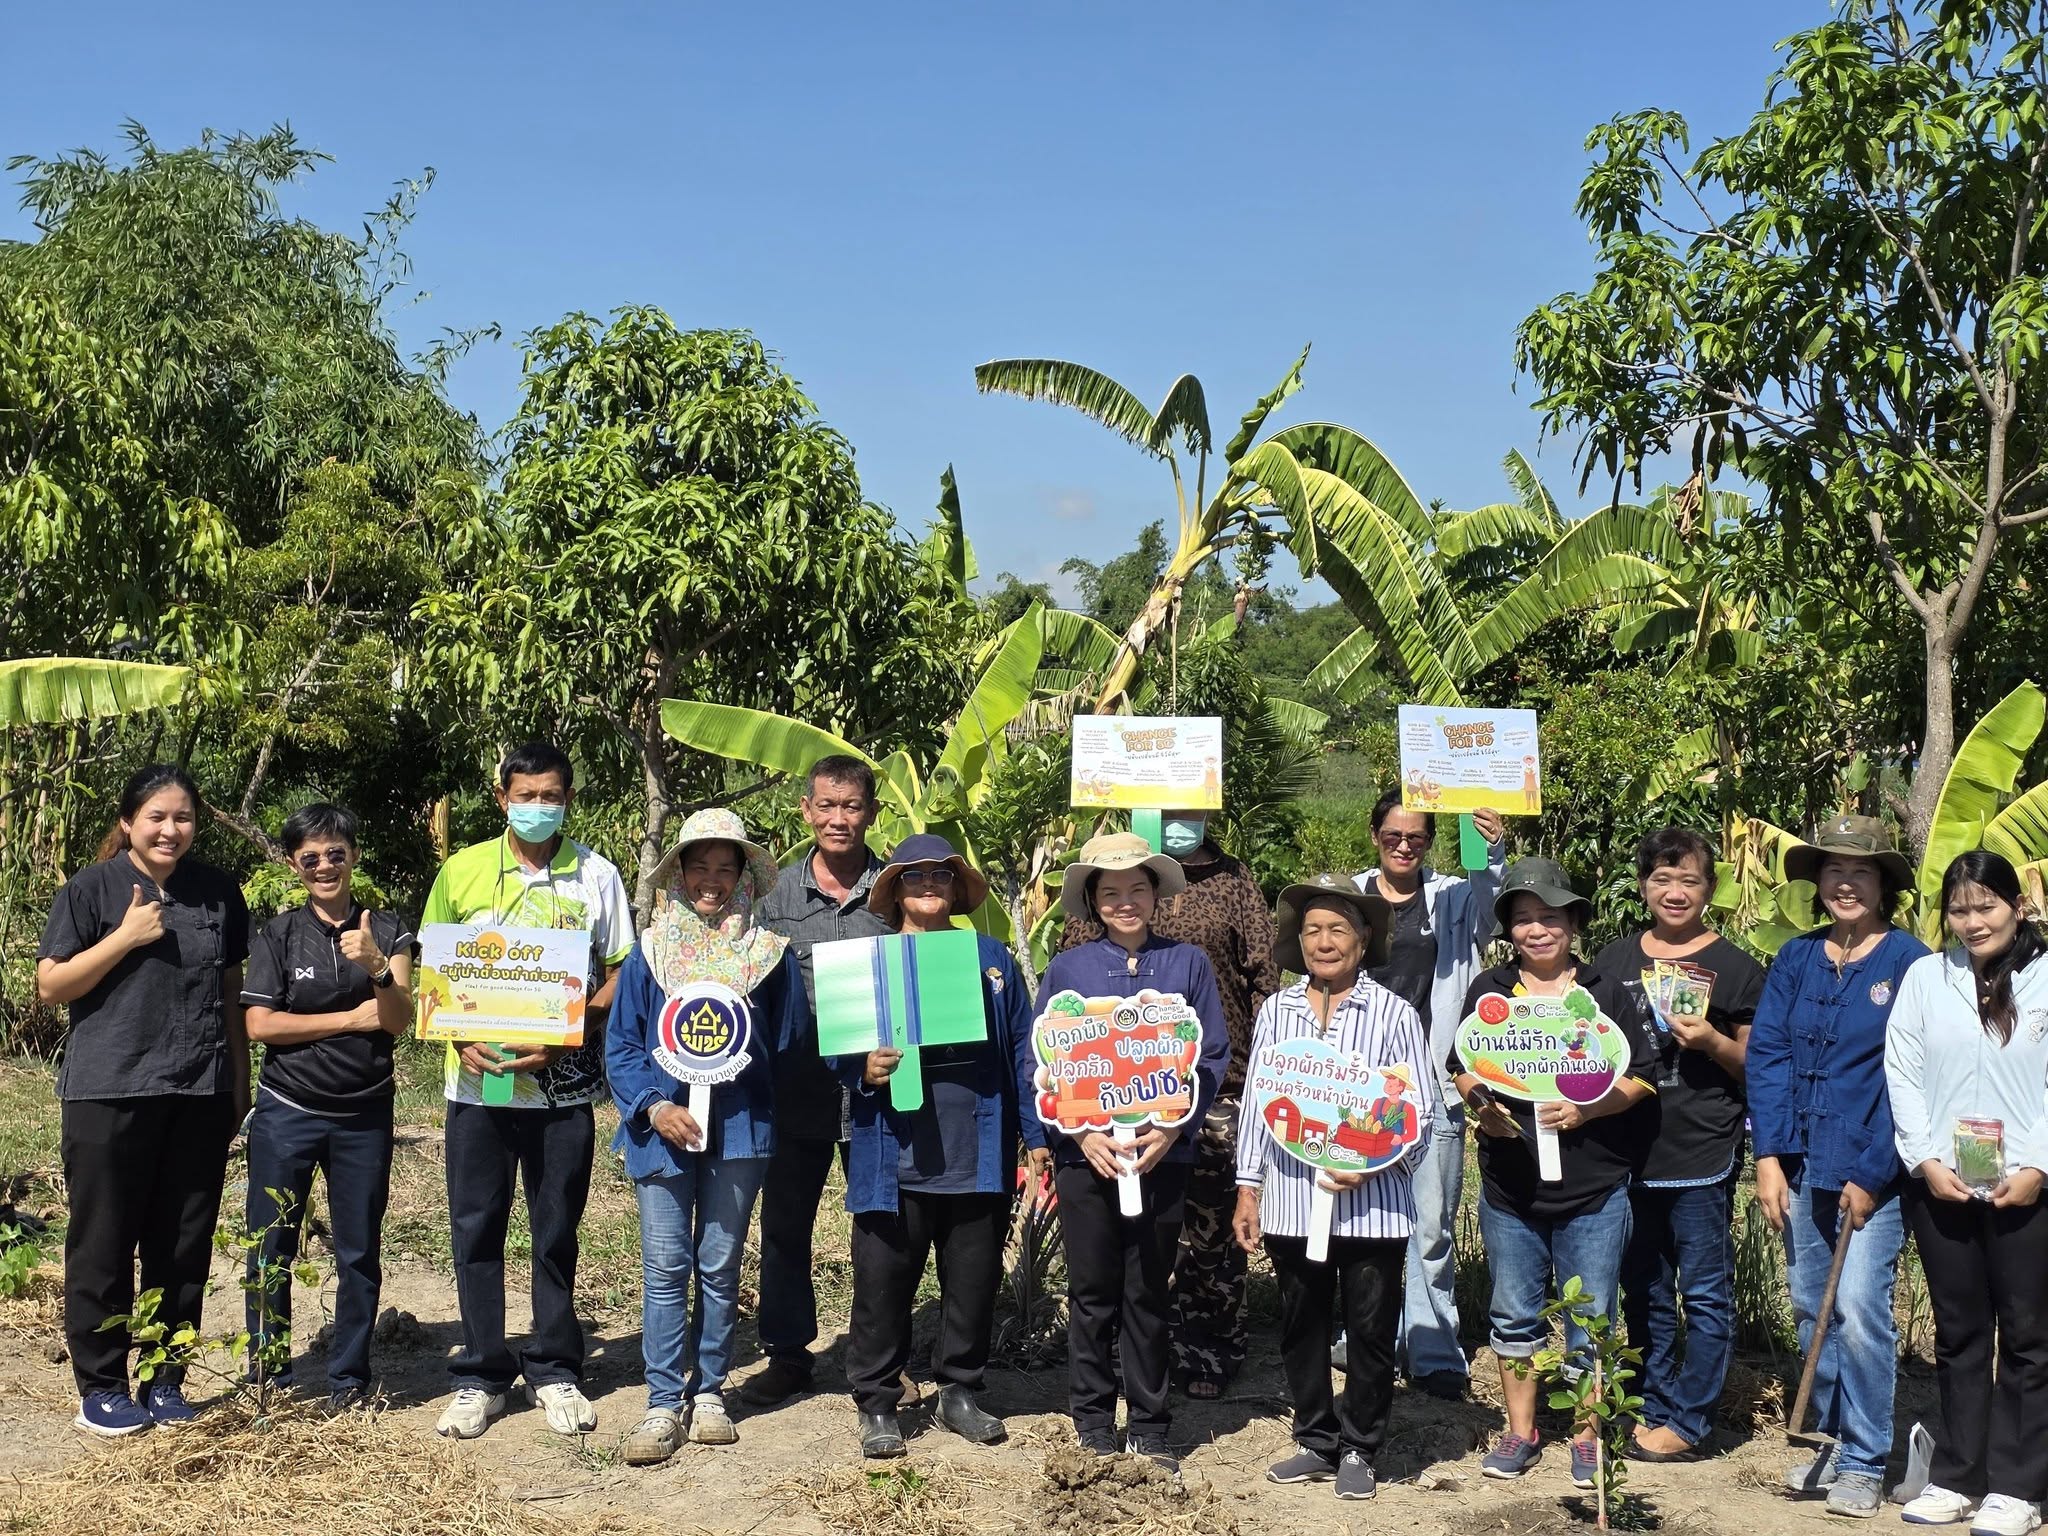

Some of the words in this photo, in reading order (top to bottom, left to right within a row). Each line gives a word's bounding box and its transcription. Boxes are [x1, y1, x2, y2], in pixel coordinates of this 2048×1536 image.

[1121, 727, 1177, 742] CHANGE
[1444, 721, 1495, 737] CHANGE
[1448, 735, 1474, 749] FOR
[1126, 740, 1153, 752] FOR
[456, 941, 502, 960] Kick
[508, 945, 543, 961] off
[1043, 1018, 1108, 1052] ปลูกพืช
[1115, 1034, 1183, 1063] ปลูกผัก
[1467, 1023, 1557, 1052] บ้านนี้มีรัก
[654, 1048, 750, 1084] กรมการพัฒนาชุมชน
[1050, 1055, 1112, 1084] ปลูกรัก
[1262, 1049, 1370, 1086] ปลูกผักริมรั้ว
[1504, 1057, 1608, 1079] ปลูกผักกินเอง
[1255, 1077, 1369, 1111] สวนครัวหน้าบ้าน
